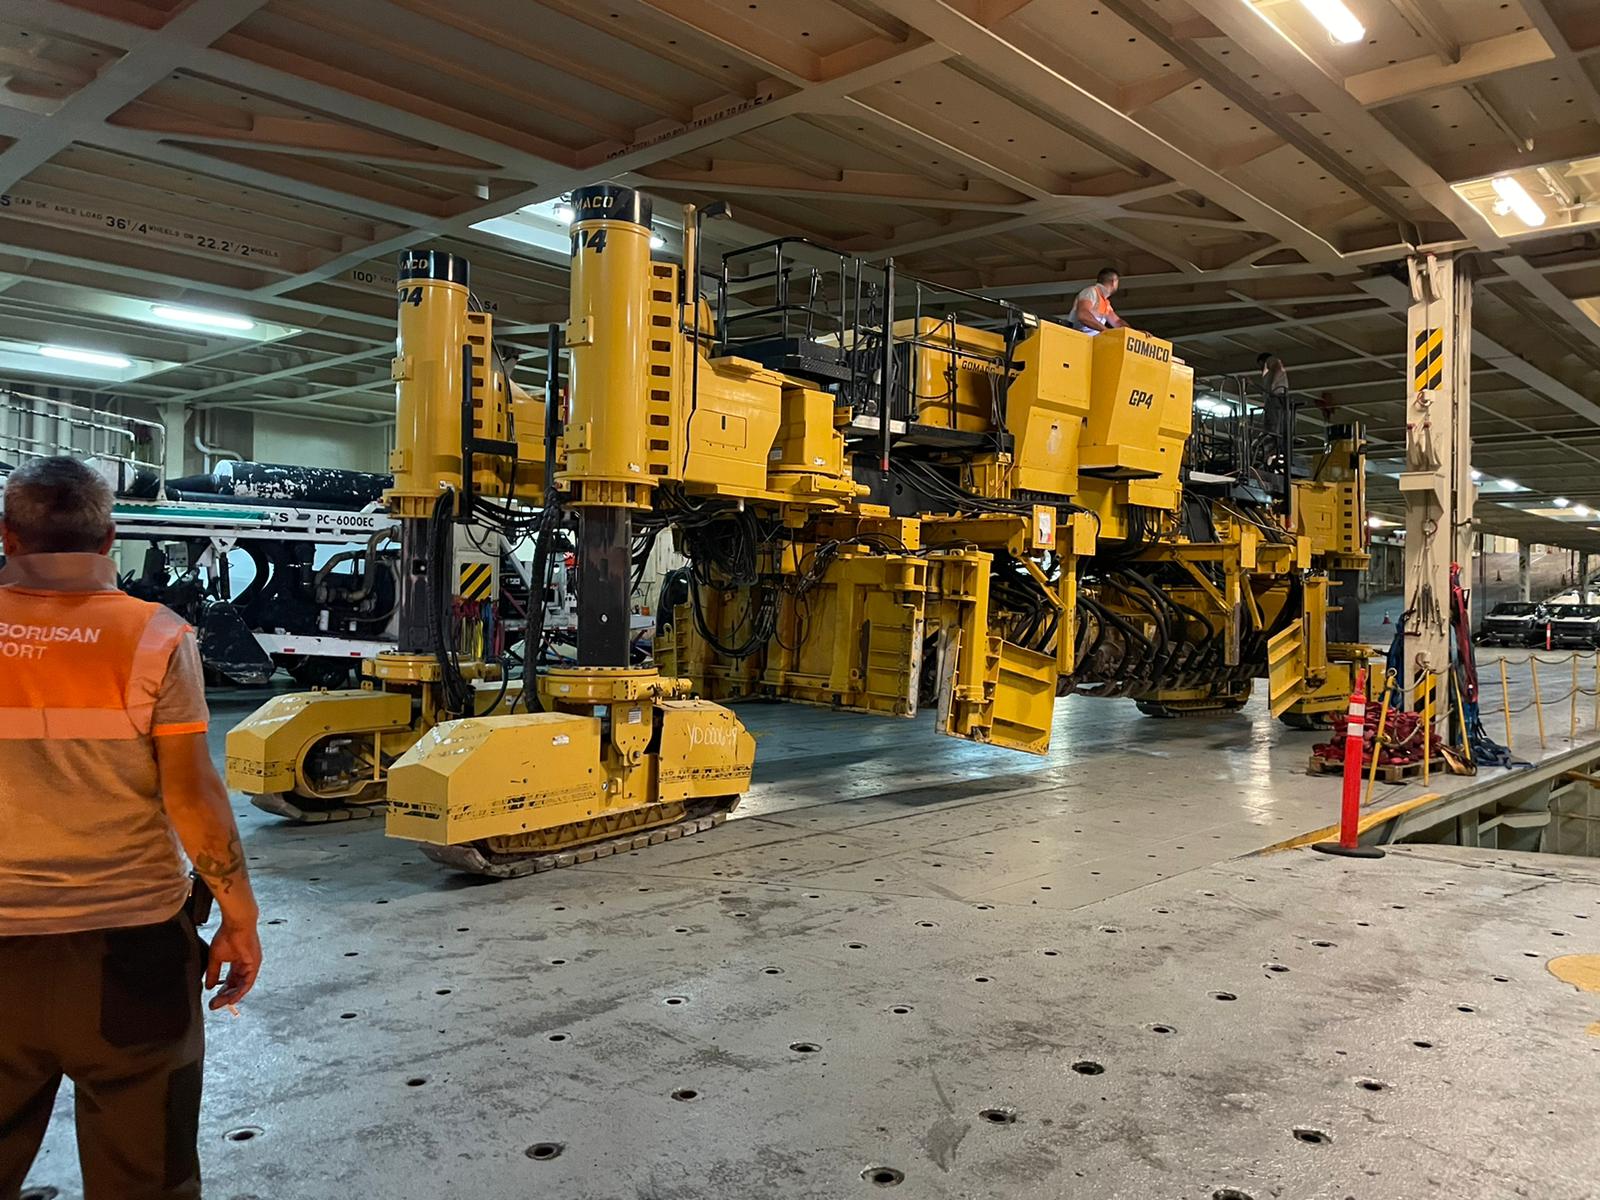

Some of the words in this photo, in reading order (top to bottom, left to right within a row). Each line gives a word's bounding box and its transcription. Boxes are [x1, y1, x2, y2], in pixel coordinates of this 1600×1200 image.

[484, 300, 498, 312] 54
[1126, 336, 1170, 363] GOMACO
[1129, 389, 1154, 409] GP4
[317, 514, 375, 528] PC-6000EC
[0, 641, 48, 660] ORT
